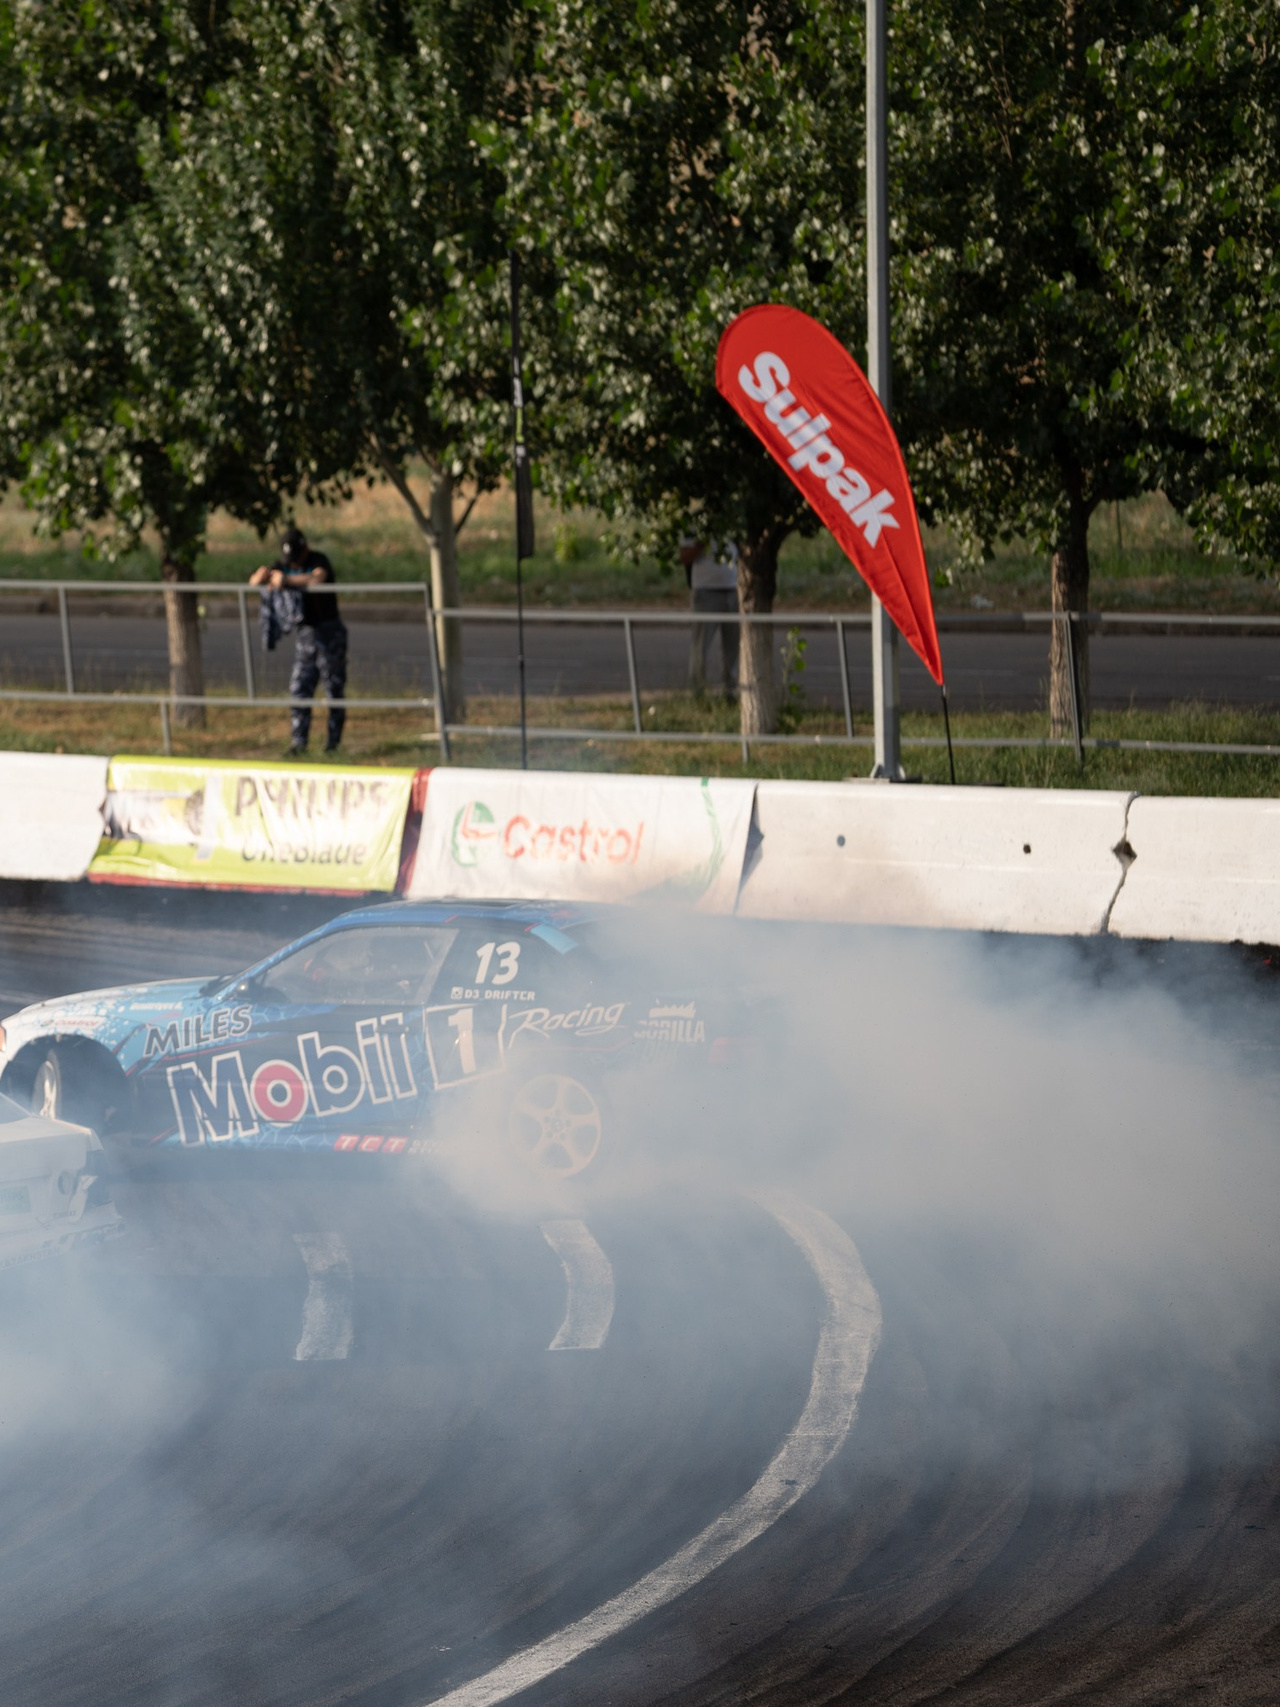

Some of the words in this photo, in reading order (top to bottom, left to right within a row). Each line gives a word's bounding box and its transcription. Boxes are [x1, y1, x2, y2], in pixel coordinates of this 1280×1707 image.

[738, 351, 900, 548] Sulpak
[503, 815, 646, 866] Castrol
[475, 941, 522, 985] 13
[143, 1004, 253, 1057] MILES
[632, 1019, 707, 1043] GORILLA
[167, 1012, 417, 1148] Mobil
[508, 1002, 628, 1050] Racing
[334, 1134, 408, 1152] TCT
